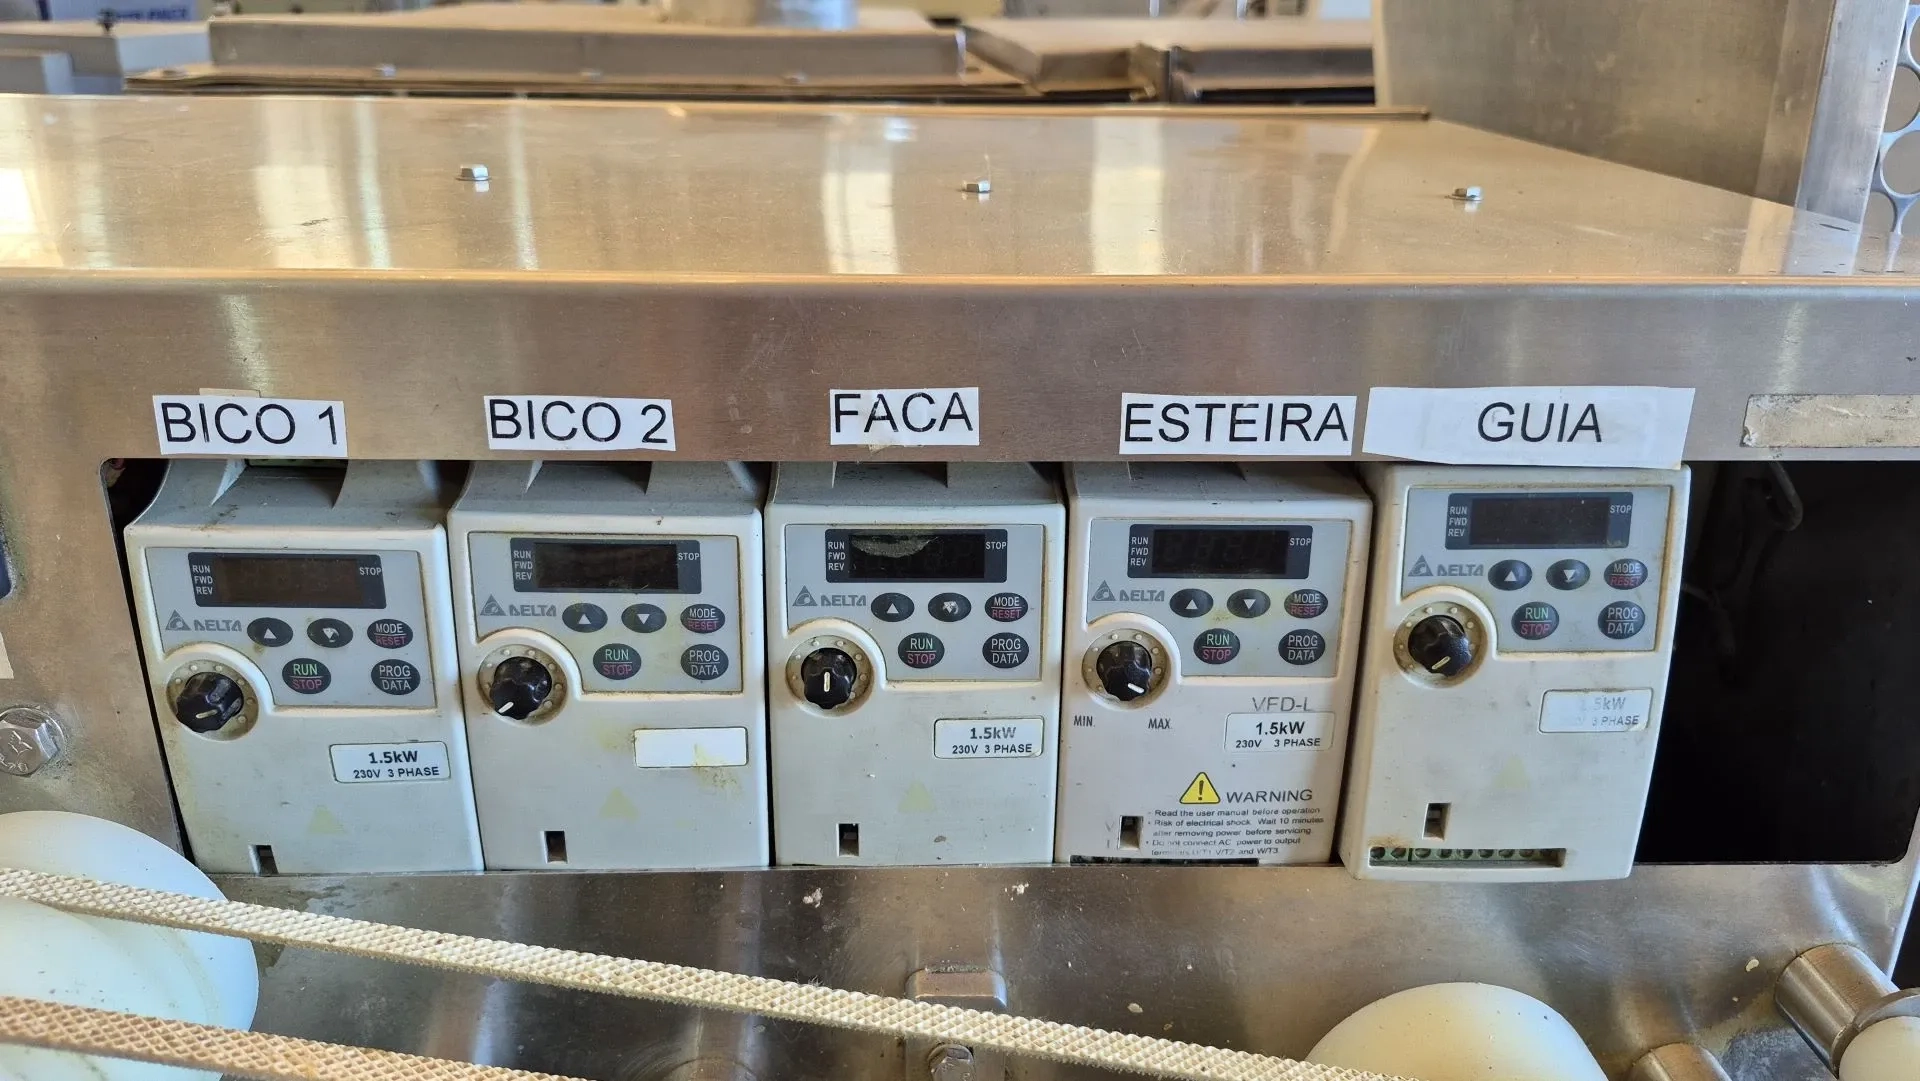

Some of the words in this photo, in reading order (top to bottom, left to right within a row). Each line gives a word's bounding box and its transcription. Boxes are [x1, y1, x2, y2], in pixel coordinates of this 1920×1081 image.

[833, 391, 973, 433] FACA
[161, 402, 296, 444] BICO
[318, 405, 338, 445] 1
[489, 398, 622, 443] BICO
[640, 404, 668, 444] 2
[1124, 402, 1349, 442] ESTEIRA
[1477, 401, 1602, 443] GUIA
[1450, 506, 1467, 515] RUN
[1609, 504, 1632, 514] STOP
[1449, 517, 1468, 526] FWD
[1448, 528, 1465, 537] REV
[827, 541, 845, 550] RUN
[985, 541, 1007, 550] STOP
[1131, 536, 1149, 545] RUN
[1289, 537, 1312, 546] STOP
[513, 550, 532, 559] RUN
[678, 552, 700, 561] STOP
[828, 551, 846, 561] FWD
[1130, 547, 1149, 556] FWD
[514, 561, 533, 570] FWD
[828, 562, 845, 571] REV
[1130, 557, 1147, 566] REV
[192, 565, 211, 573] RUN
[359, 567, 382, 576] STOP
[1436, 564, 1484, 577] DELTA
[1613, 563, 1640, 574] MODE
[194, 575, 213, 584] FWD
[515, 571, 532, 580] REV
[1609, 575, 1640, 586] RESET
[196, 586, 213, 595] REV
[1119, 589, 1165, 602] DELTA
[820, 594, 867, 607] DELTA
[994, 596, 1020, 607] MODE
[1294, 593, 1320, 603] MODE
[509, 604, 557, 617] DELTA
[689, 607, 716, 618] MODE
[991, 608, 1021, 619] RESET
[1291, 605, 1321, 616] RESET
[1525, 607, 1549, 620] RUN
[1607, 607, 1638, 620] PROG
[193, 619, 242, 632] DELTA
[375, 623, 404, 634] MODE
[688, 621, 718, 631] RESET
[1520, 623, 1550, 635] STOP
[1607, 622, 1635, 634] DATA
[376, 636, 406, 646] RESET
[910, 638, 933, 649] RUN
[991, 638, 1021, 650] PROG
[1206, 634, 1230, 645] RUN
[1288, 635, 1318, 647] PROG
[605, 649, 629, 661] RUN
[689, 650, 720, 662] PROG
[907, 653, 936, 664] STOP
[992, 653, 1020, 664] DATA
[1202, 649, 1232, 660] STOP
[1287, 649, 1315, 661] DATA
[293, 663, 318, 675] RUN
[379, 665, 411, 677] PROG
[602, 664, 633, 676] STOP
[691, 664, 719, 676] DATA
[292, 679, 322, 690] STOP
[382, 680, 411, 691] DATA
[1251, 696, 1315, 712] VFD-L
[1580, 696, 1626, 711] 15kW
[1601, 715, 1640, 726] PHASE
[969, 726, 1017, 740] 1.5kW
[1255, 721, 1306, 736] 1.5kW
[1235, 739, 1262, 749] 230V
[1273, 738, 1281, 748] 3
[1283, 737, 1321, 748] PHASE
[951, 745, 978, 755] 230V
[984, 744, 991, 754] 3
[993, 743, 1033, 754] PHASE
[368, 750, 418, 764] 1.5kW
[353, 769, 381, 779] 230V
[387, 768, 395, 778] 3
[397, 766, 440, 778] PHASE
[1226, 789, 1313, 803] WARNING
[1154, 809, 1178, 817] Read
[1180, 809, 1194, 817] the
[1217, 809, 1249, 817] manual
[1252, 808, 1279, 816] before
[1281, 807, 1321, 816] operation
[1154, 819, 1173, 827] Risk
[1175, 819, 1184, 827] of
[1186, 819, 1224, 827] electrical
[1257, 817, 1277, 826] Wait
[1280, 817, 1289, 825] 10
[1291, 816, 1325, 825] minutes
[1174, 829, 1213, 838] removing
[1216, 830, 1241, 838] power
[1245, 828, 1272, 836] before
[1218, 838, 1231, 846] AC
[1236, 838, 1261, 847] power
[1274, 837, 1301, 846] output
[1151, 848, 1190, 856] termals
[1238, 847, 1254, 855] and
[1257, 846, 1279, 855] W/T3
